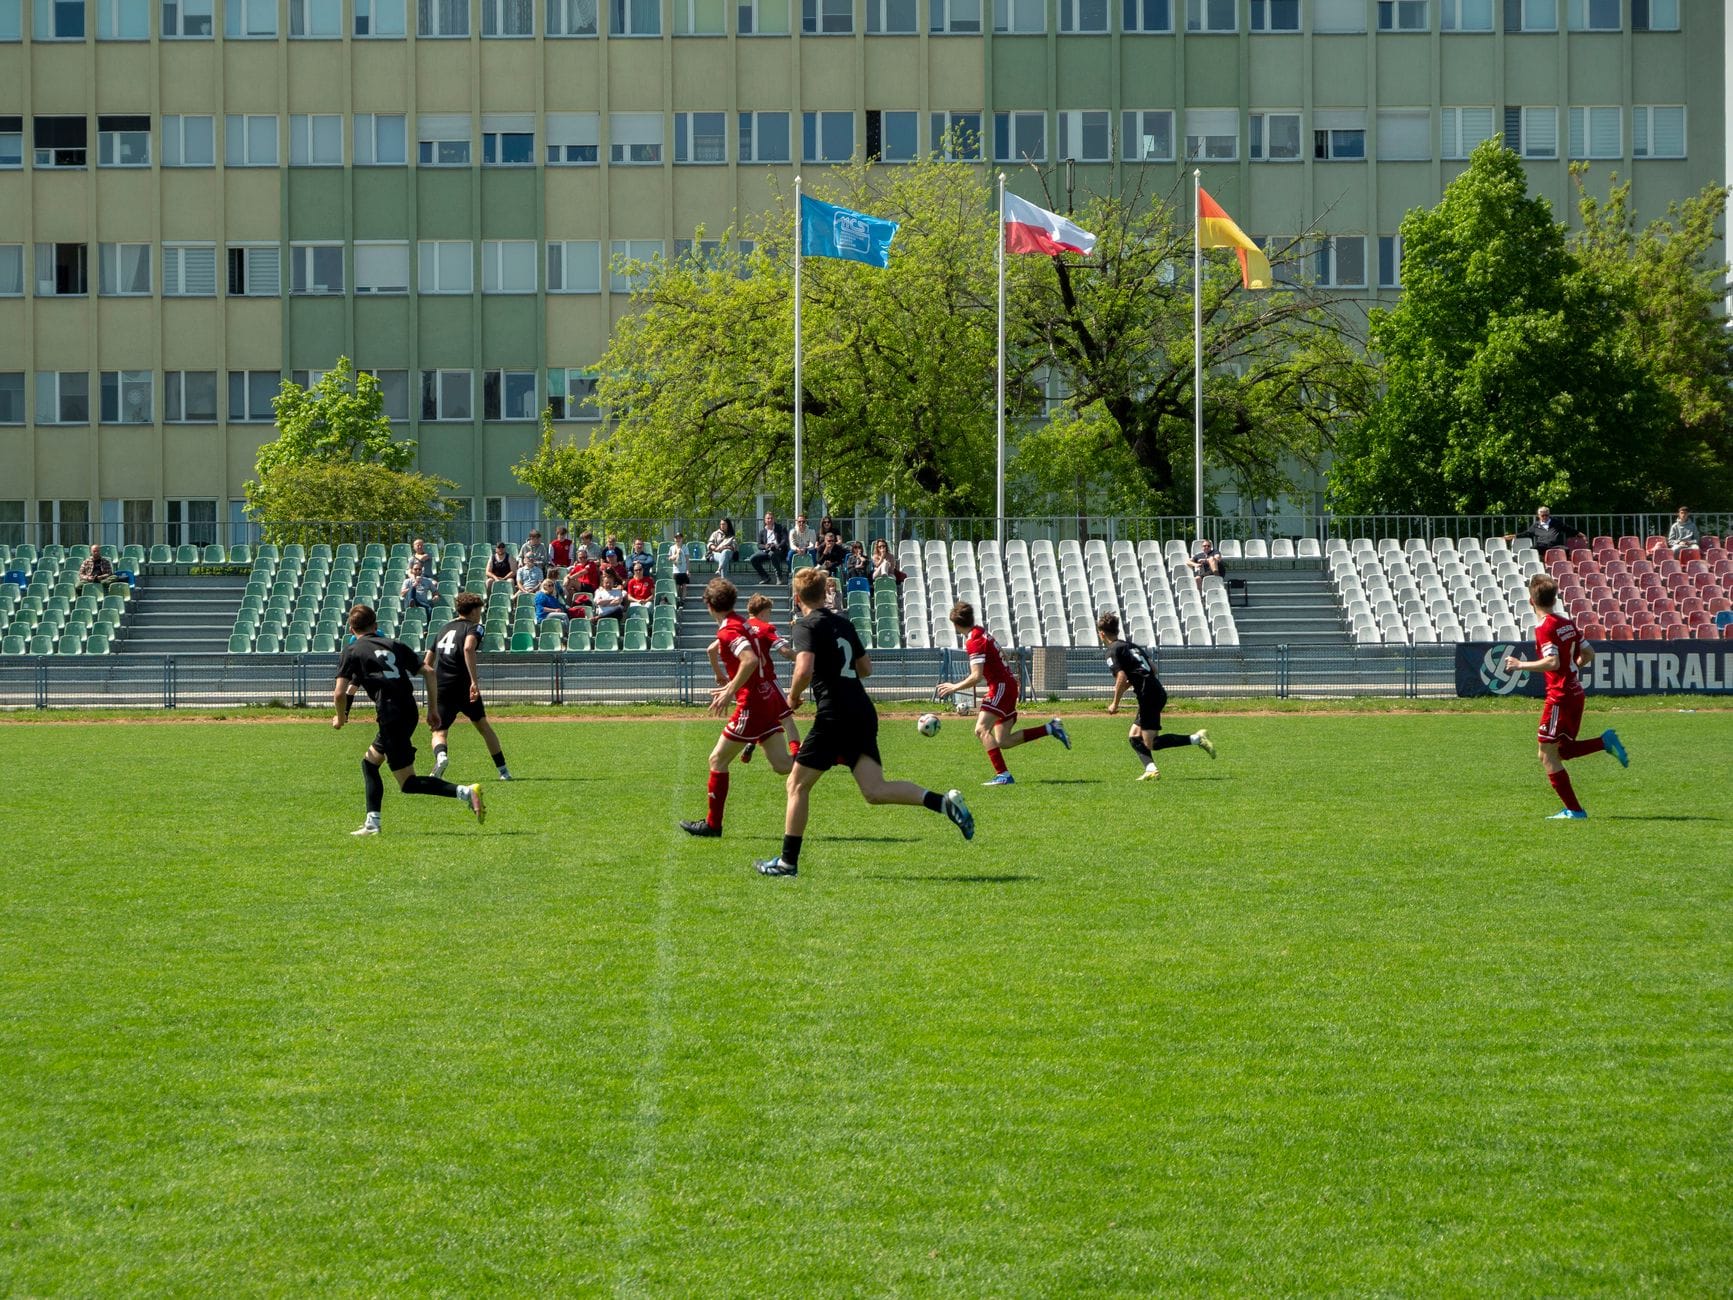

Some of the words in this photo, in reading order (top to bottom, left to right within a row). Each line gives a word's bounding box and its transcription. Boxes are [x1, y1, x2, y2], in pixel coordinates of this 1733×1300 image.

[437, 629, 457, 655] 4
[374, 649, 401, 680] 3
[836, 637, 857, 679] 2
